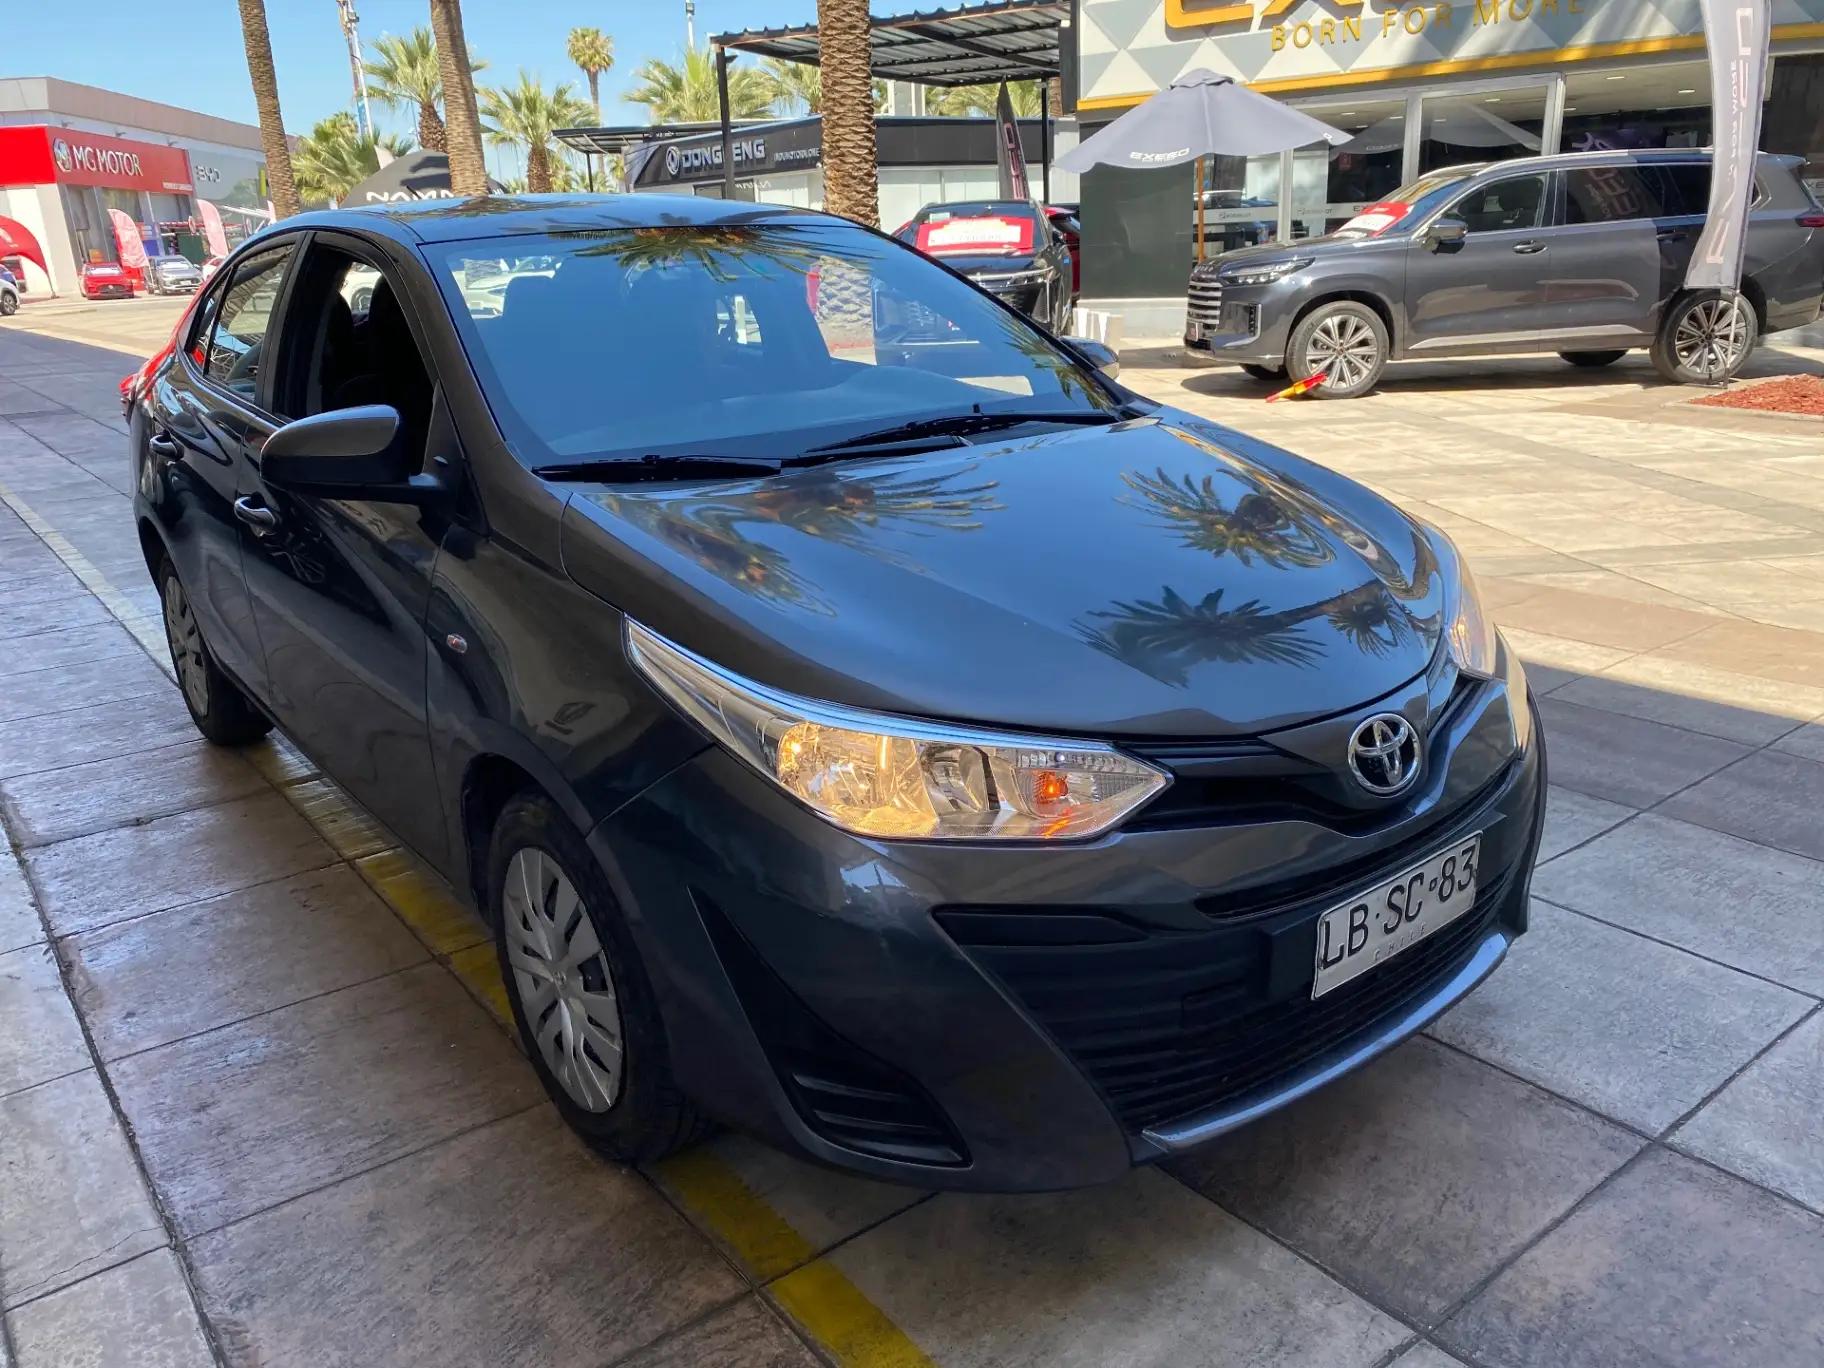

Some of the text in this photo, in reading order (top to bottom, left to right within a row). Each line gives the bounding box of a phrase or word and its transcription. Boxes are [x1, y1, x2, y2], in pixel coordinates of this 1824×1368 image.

[1271, 15, 1362, 51] BORN
[1383, 3, 1451, 38] FOR
[71, 144, 96, 172] MG
[95, 148, 144, 177] MOTOR
[682, 139, 766, 168] DONGENG
